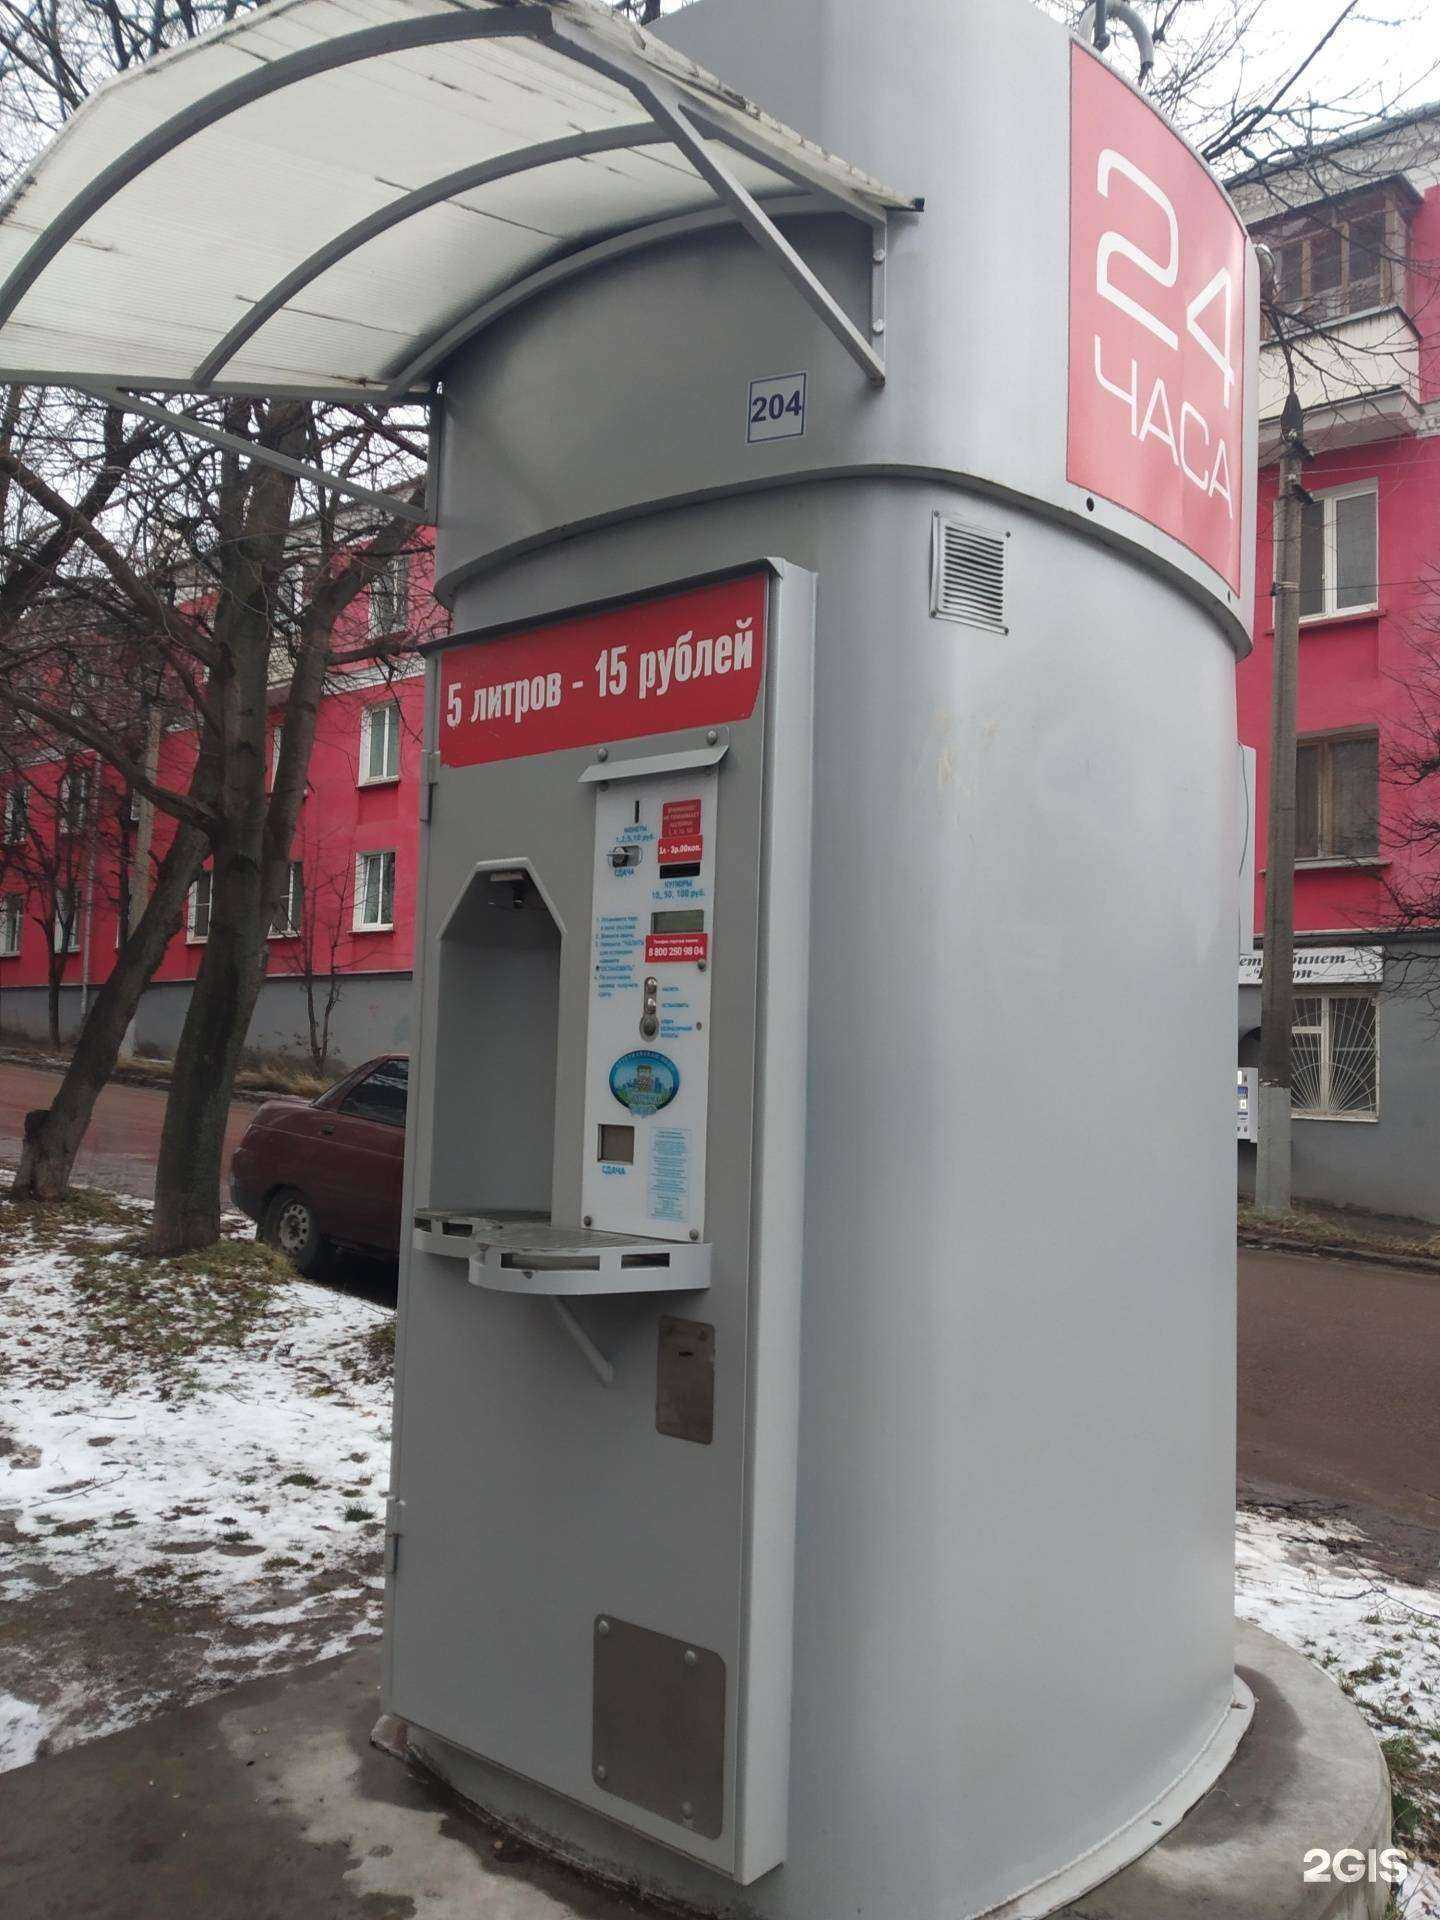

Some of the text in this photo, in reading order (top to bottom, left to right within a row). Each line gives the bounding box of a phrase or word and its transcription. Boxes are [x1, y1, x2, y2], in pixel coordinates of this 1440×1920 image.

[1096, 148, 1235, 410] 24
[751, 390, 802, 423] 204
[1094, 334, 1234, 520] ЧАСА
[446, 682, 462, 728] 5
[470, 672, 563, 724] литров
[595, 645, 628, 698] 15
[639, 617, 754, 700] рублей
[602, 1166, 625, 1176] СДАЧА
